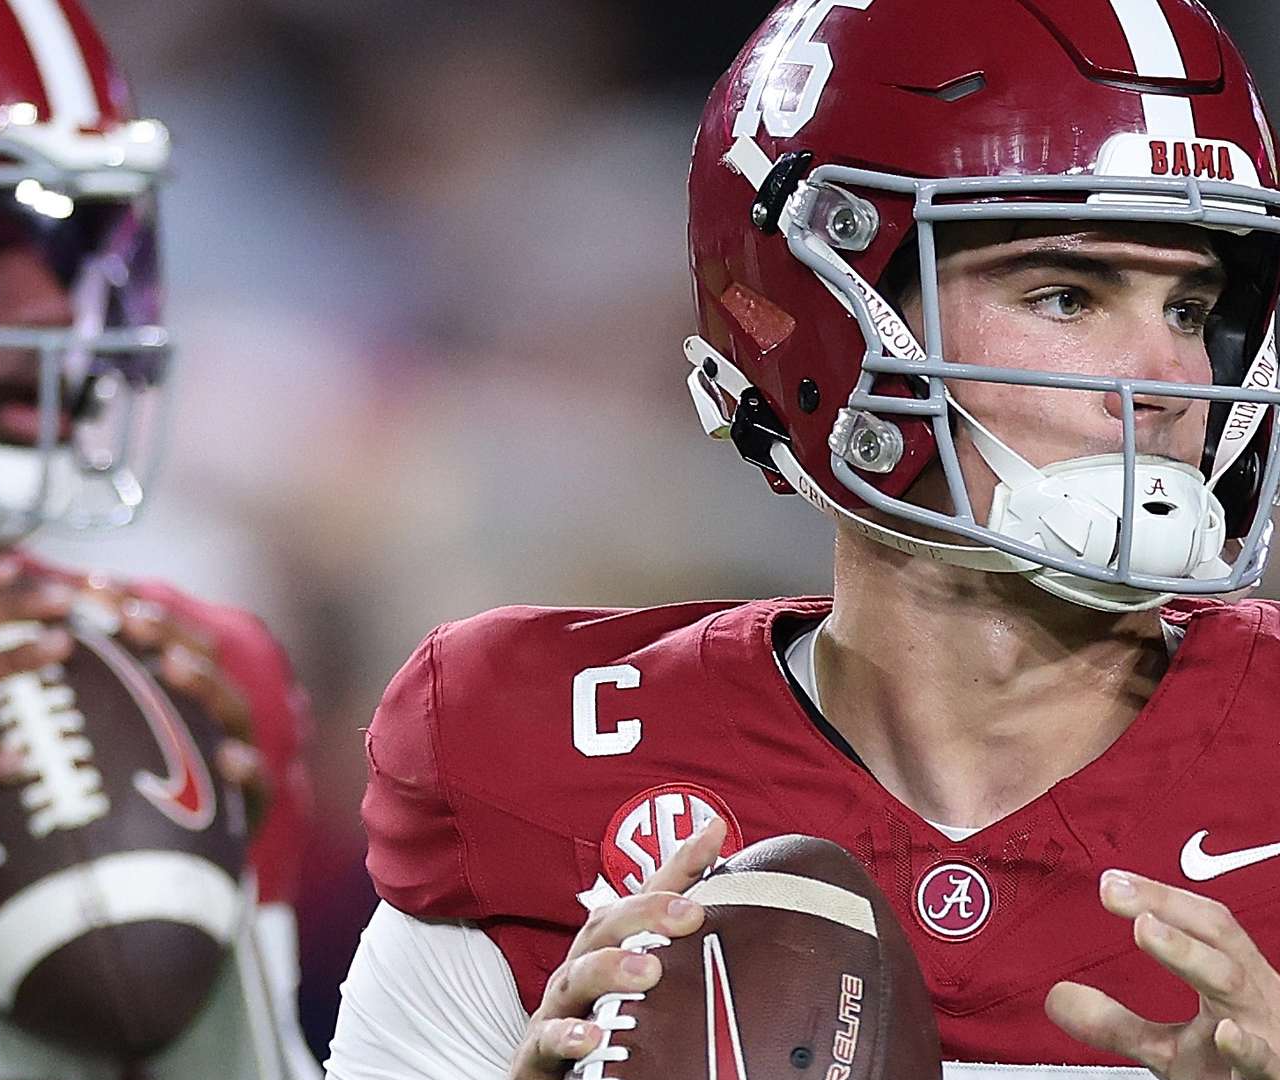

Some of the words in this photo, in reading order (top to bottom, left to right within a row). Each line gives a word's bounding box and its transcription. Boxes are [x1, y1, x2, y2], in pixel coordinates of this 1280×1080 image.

[731, 0, 875, 138] 15
[1149, 140, 1234, 181] BAMA
[1225, 355, 1275, 441] CRIMON
[1144, 477, 1168, 497] A
[573, 663, 642, 758] C
[928, 875, 973, 919] A
[833, 973, 864, 1065] ELITE
